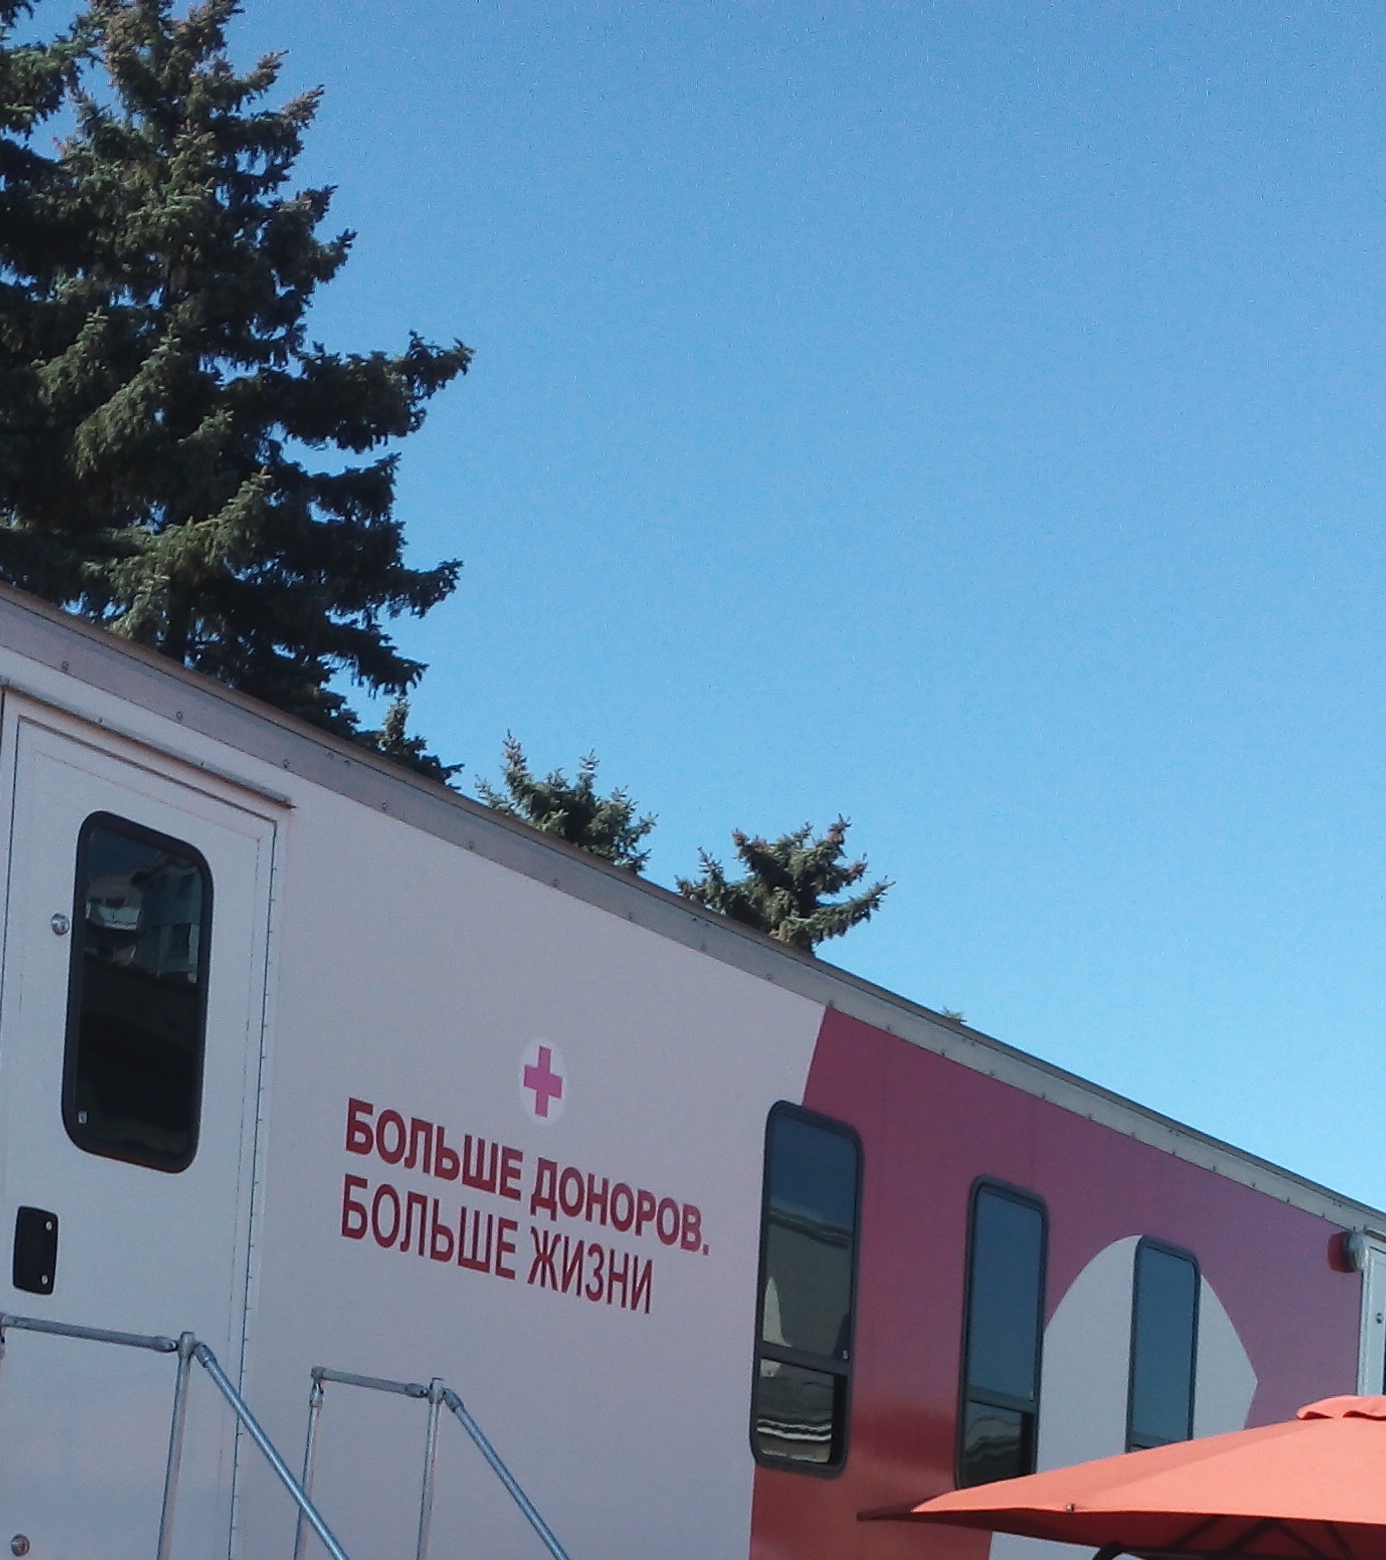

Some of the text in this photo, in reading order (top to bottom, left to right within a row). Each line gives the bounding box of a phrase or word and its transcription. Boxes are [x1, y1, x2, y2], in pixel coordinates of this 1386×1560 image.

[341, 1173, 653, 1315] БОЛЬШЕ ЖИЗНИ
[345, 1096, 710, 1256] БОЛЬШЕ ДОНОРОВ.
